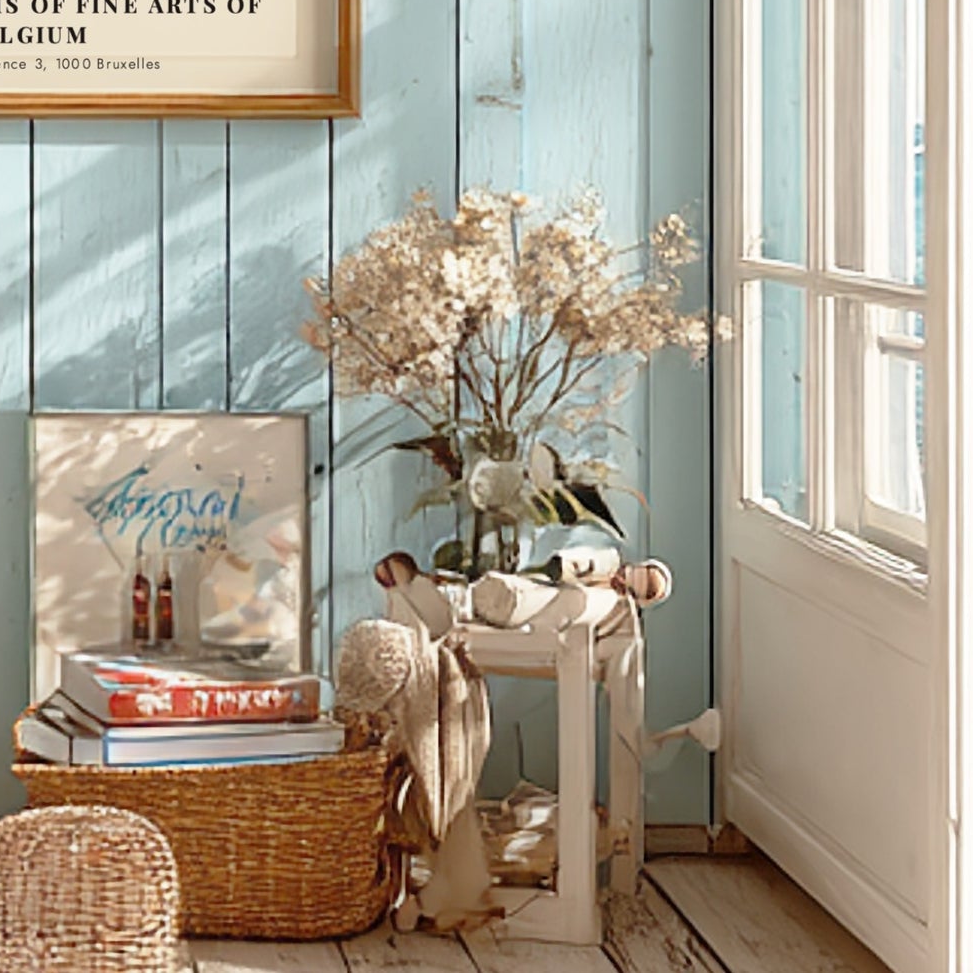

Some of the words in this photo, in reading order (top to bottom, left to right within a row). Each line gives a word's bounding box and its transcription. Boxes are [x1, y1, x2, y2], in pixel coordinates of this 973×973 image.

[34, 57, 47, 72] 3,
[55, 57, 92, 70] 1000
[96, 56, 161, 70] Bruxelles
